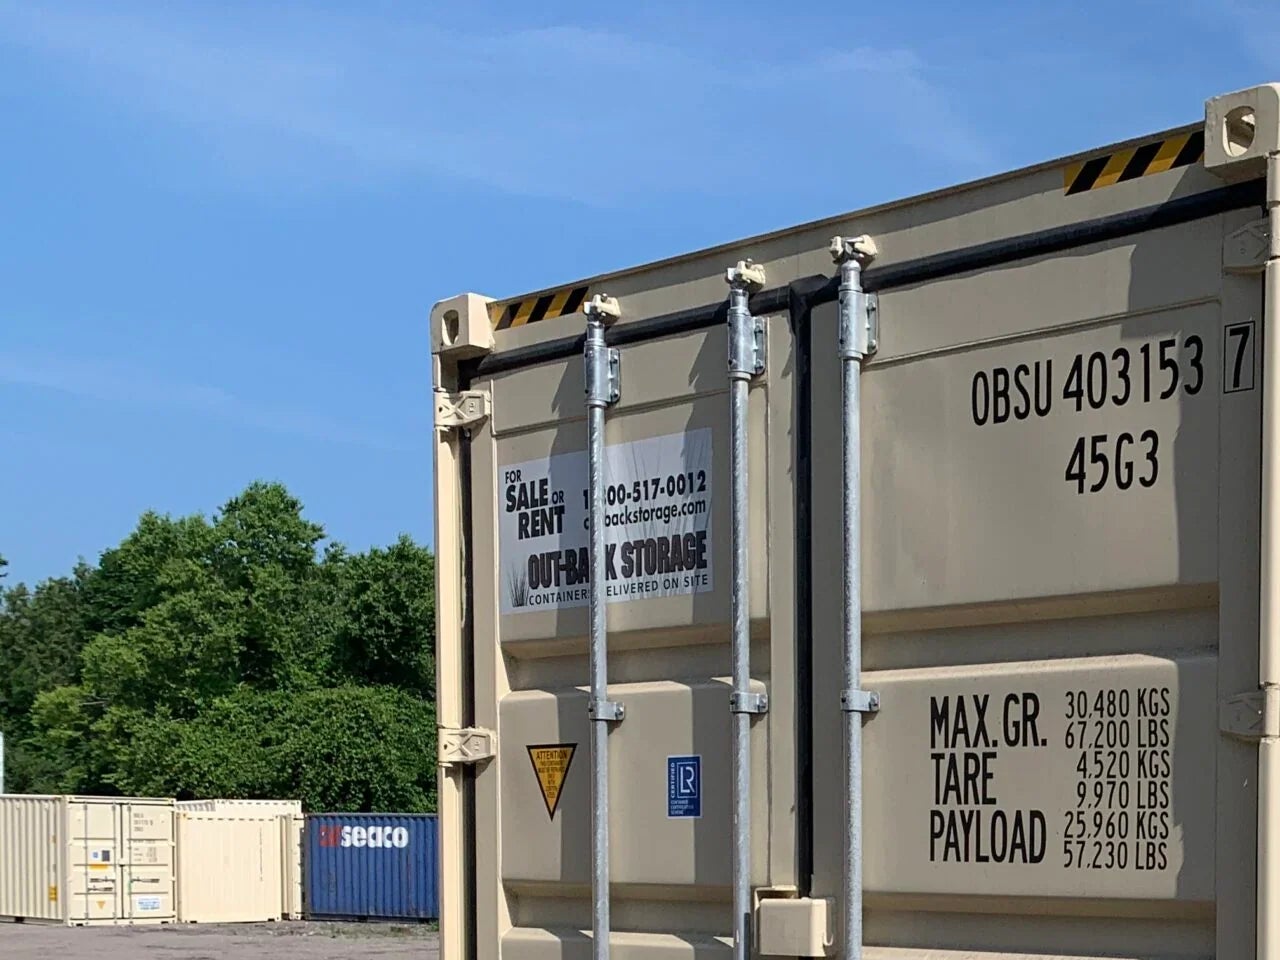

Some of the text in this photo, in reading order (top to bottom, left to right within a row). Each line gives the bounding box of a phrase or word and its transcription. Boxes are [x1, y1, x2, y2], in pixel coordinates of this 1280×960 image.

[972, 325, 1251, 426] OBSU 403153 7
[504, 469, 522, 485] FOR
[1065, 429, 1159, 494] 45G3
[505, 478, 564, 512] SALE OR
[518, 506, 565, 540] RENT
[528, 531, 707, 589] OUT-BAK STORAGE
[529, 574, 708, 606] CONTAINER ELIVERED ON SITE
[1065, 688, 1170, 719] 30,480 KGS
[1065, 719, 1169, 749] 67,200 LBS
[931, 752, 997, 805] TARE
[1077, 750, 1170, 779] 4,520 KGS
[1077, 781, 1169, 809] 9,970 LBS
[341, 825, 408, 848] seaco
[930, 810, 1047, 863] PAYLOAD
[1064, 811, 1169, 839] 25,960 KGS
[1064, 841, 1167, 870] 57,230 LBS
